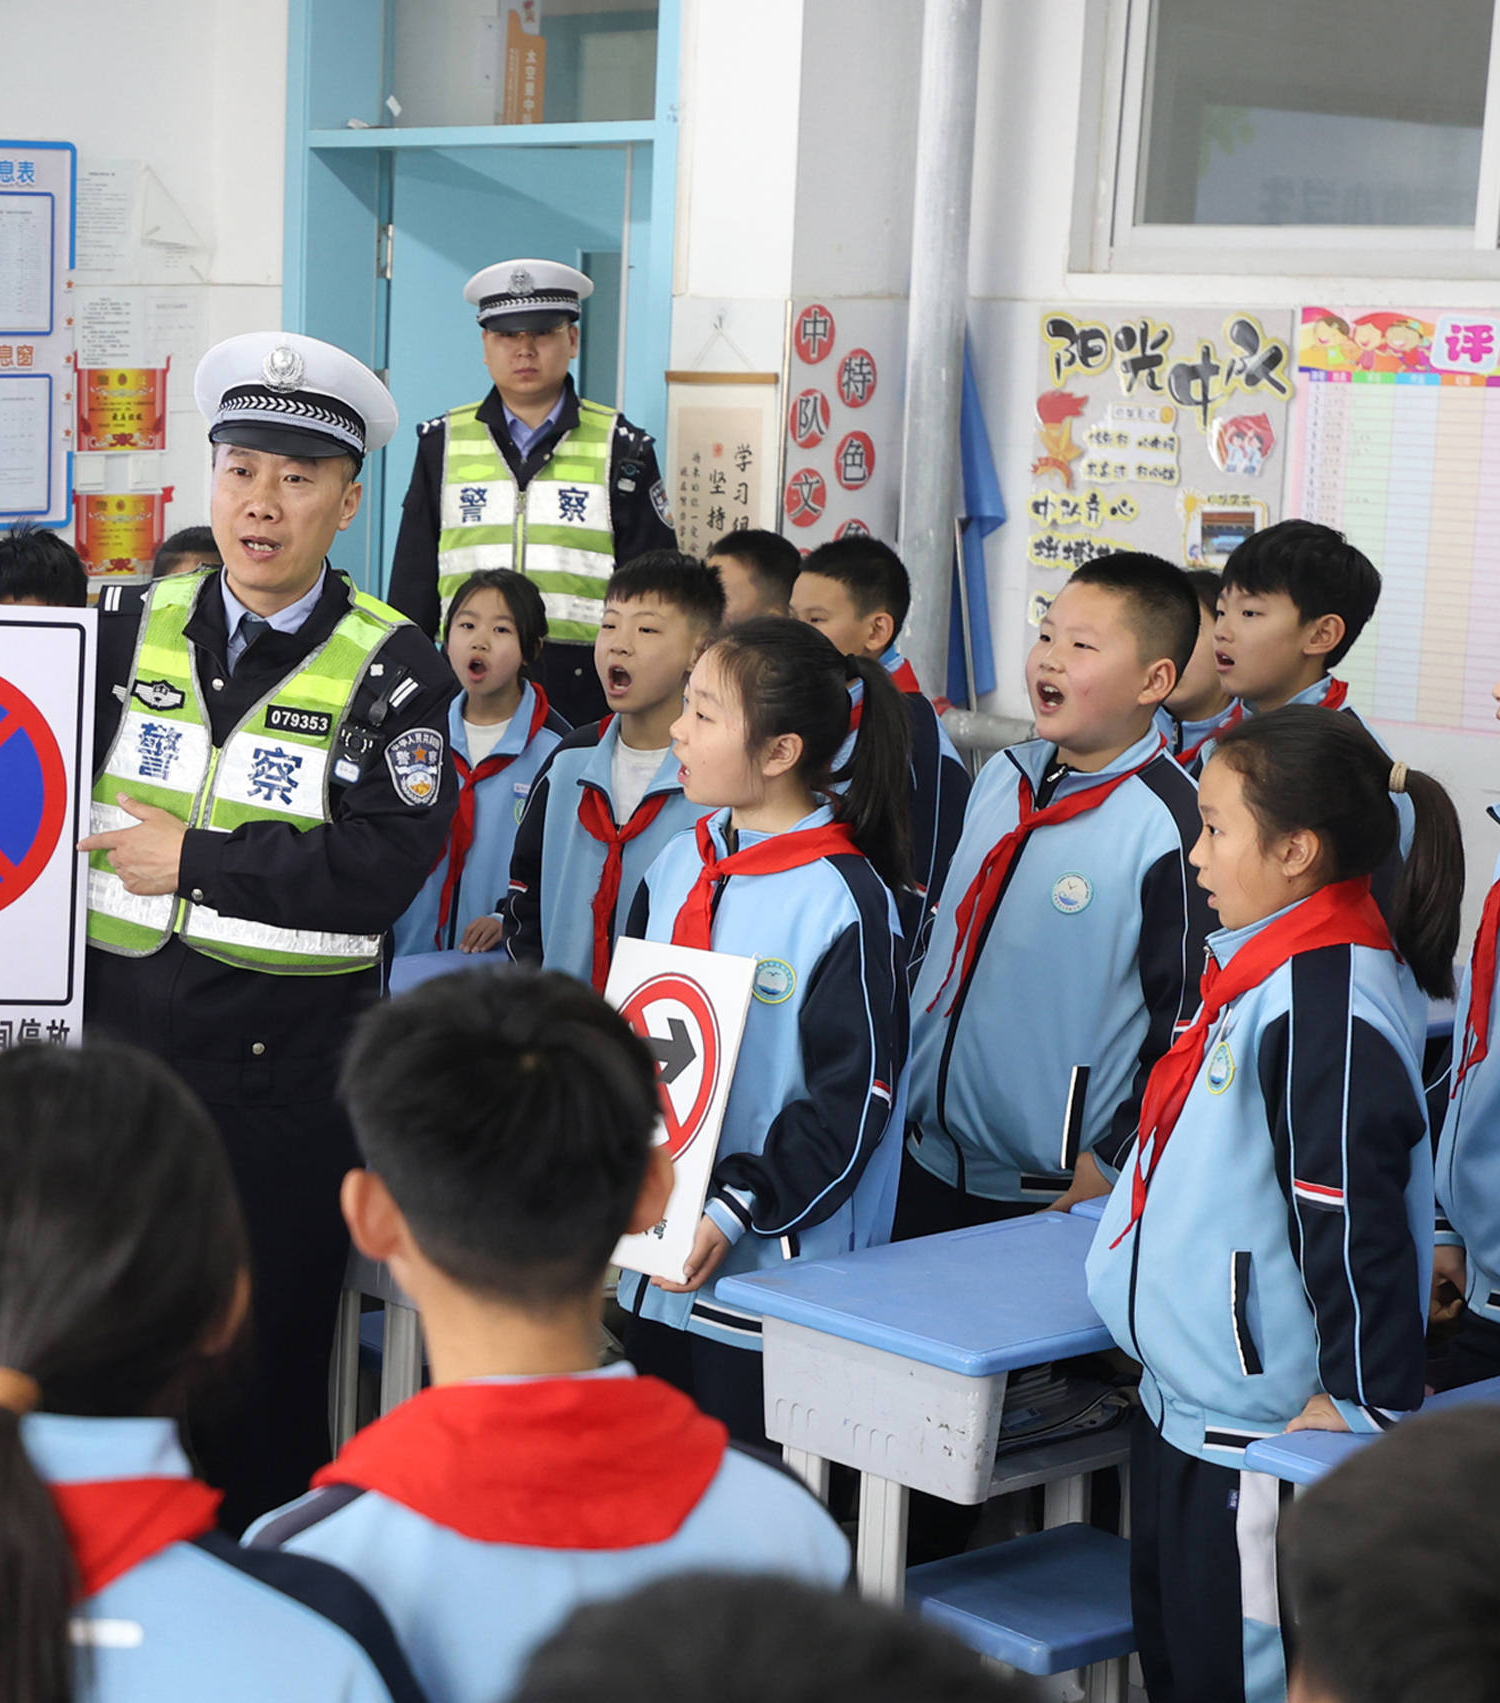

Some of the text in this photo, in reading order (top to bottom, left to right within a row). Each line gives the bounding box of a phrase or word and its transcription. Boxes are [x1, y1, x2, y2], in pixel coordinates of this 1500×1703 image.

[1445, 324, 1494, 363] 评
[1047, 319, 1287, 431] 阳光中队
[459, 487, 589, 523] 警 察
[271, 710, 328, 731] 079353
[137, 721, 303, 806] 警 察
